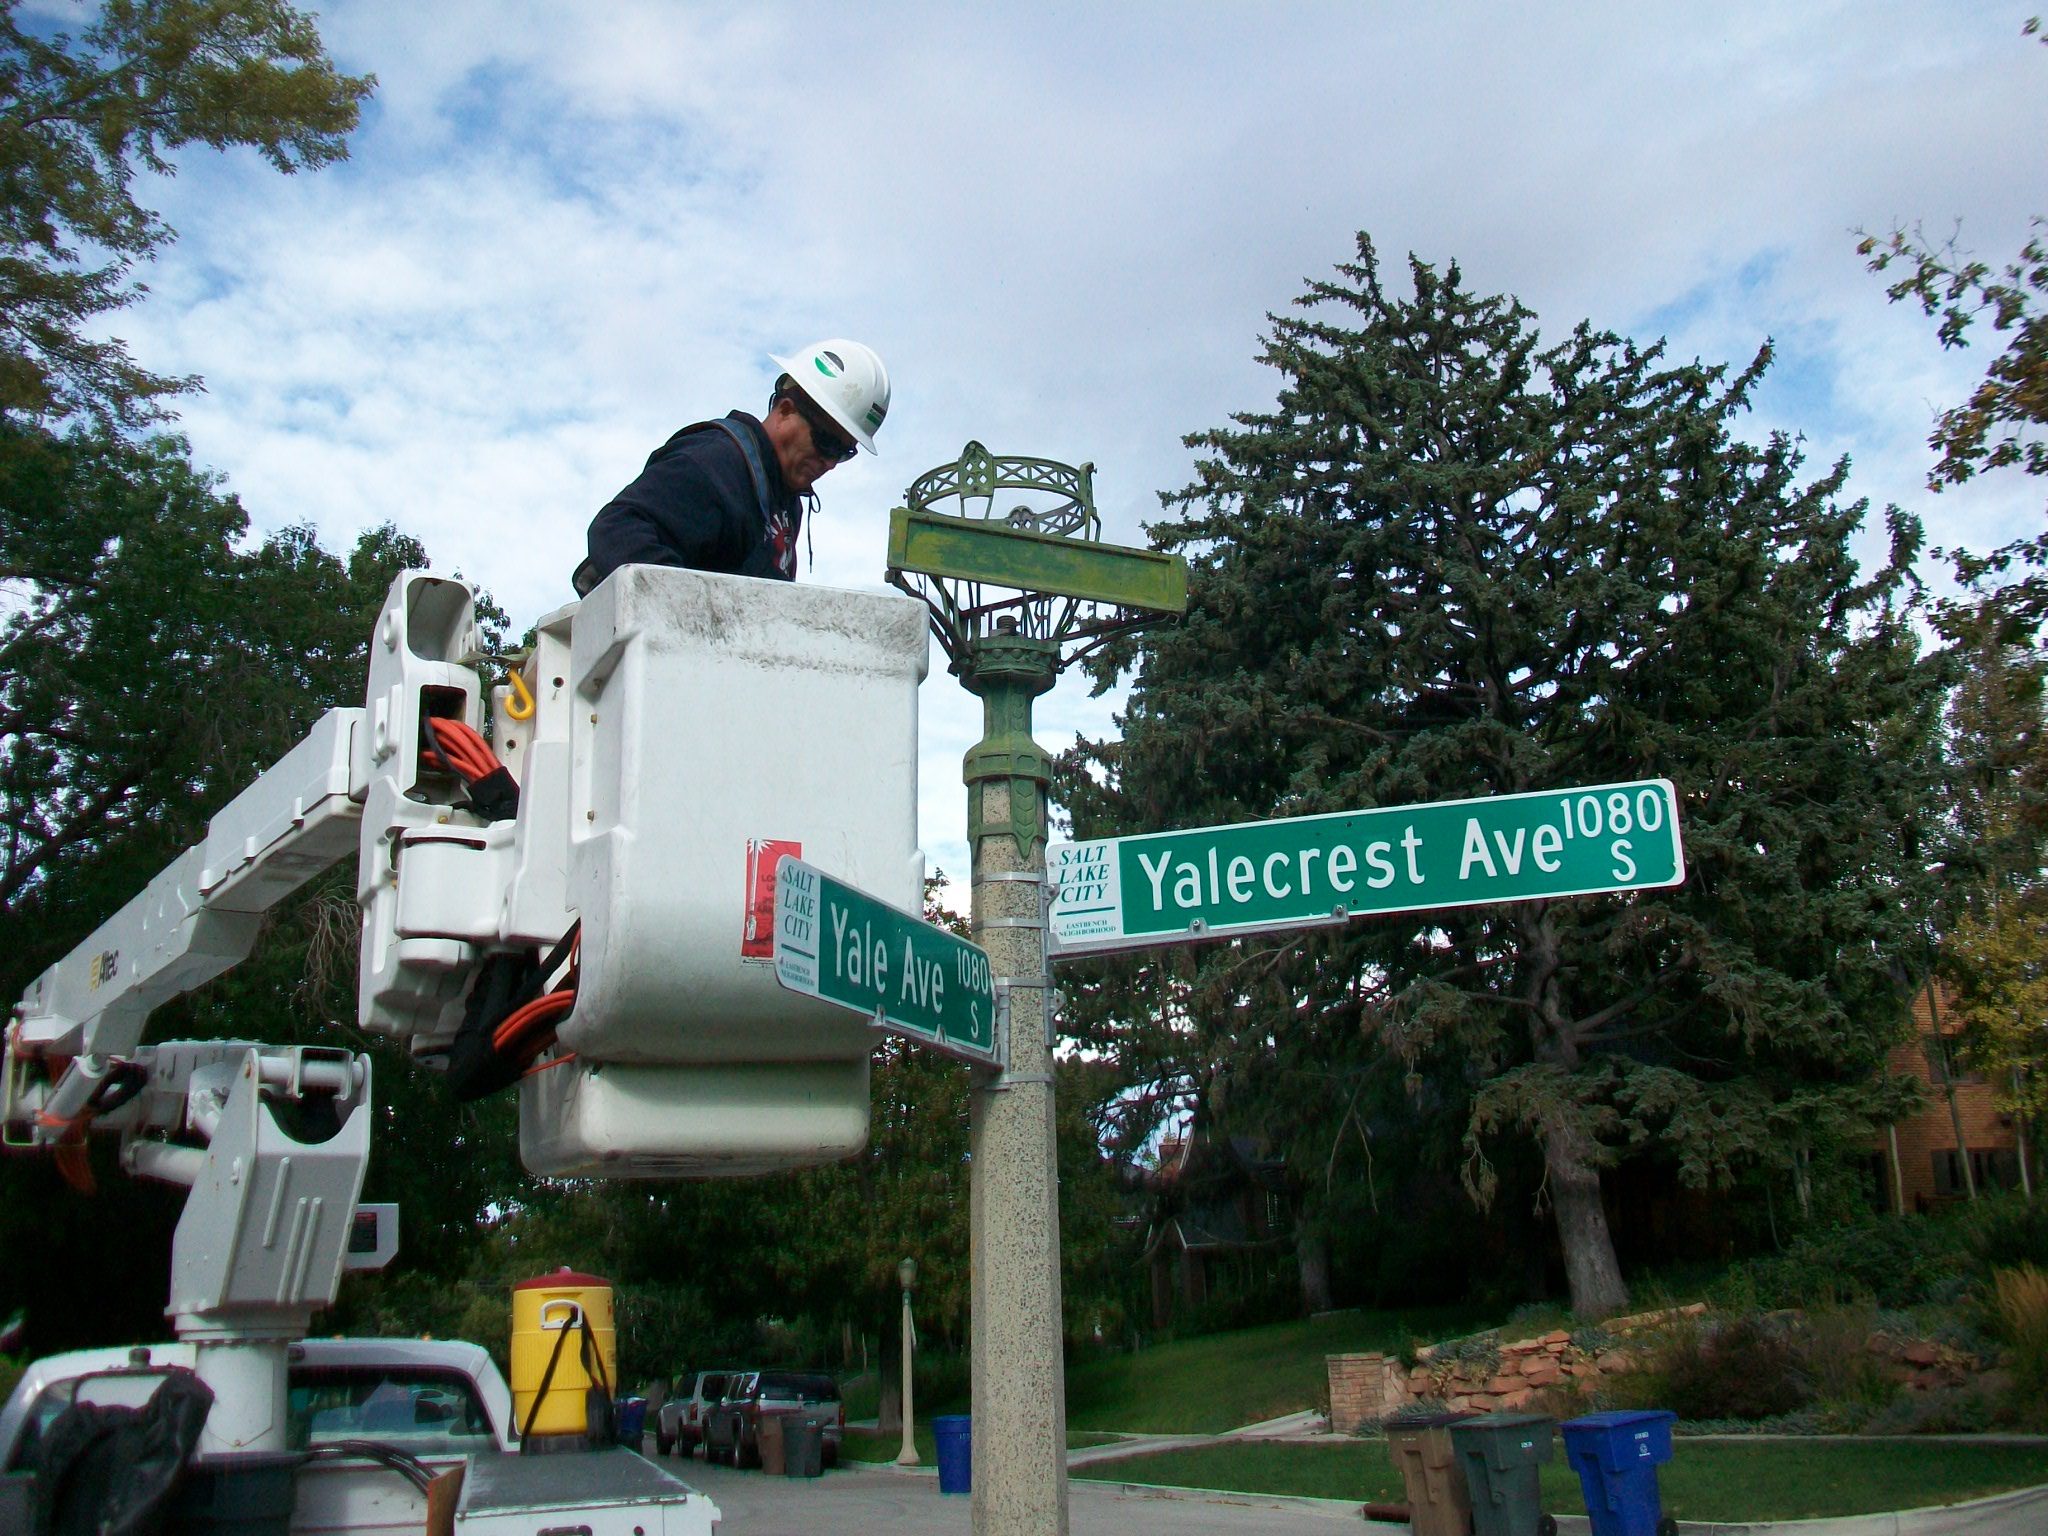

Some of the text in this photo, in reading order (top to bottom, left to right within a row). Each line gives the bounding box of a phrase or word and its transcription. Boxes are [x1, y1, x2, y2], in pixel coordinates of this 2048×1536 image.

[1560, 788, 1662, 839] 1080
[1059, 845, 1107, 865] SALT
[1137, 817, 1564, 911] Yalecrest Ave
[1610, 838, 1637, 882] S
[786, 864, 815, 893] SALT
[1059, 864, 1110, 884] LAKE
[784, 888, 815, 918] LAKE
[1061, 883, 1108, 903] CITY
[784, 914, 813, 941] CITY
[1059, 926, 1116, 937] NEIGHBORHOOD
[1066, 920, 1108, 930] EASTBENCH
[98, 949, 119, 987] Altec
[830, 901, 944, 1014] Yale Ave
[956, 946, 989, 995] 1080
[970, 1000, 979, 1038] S
